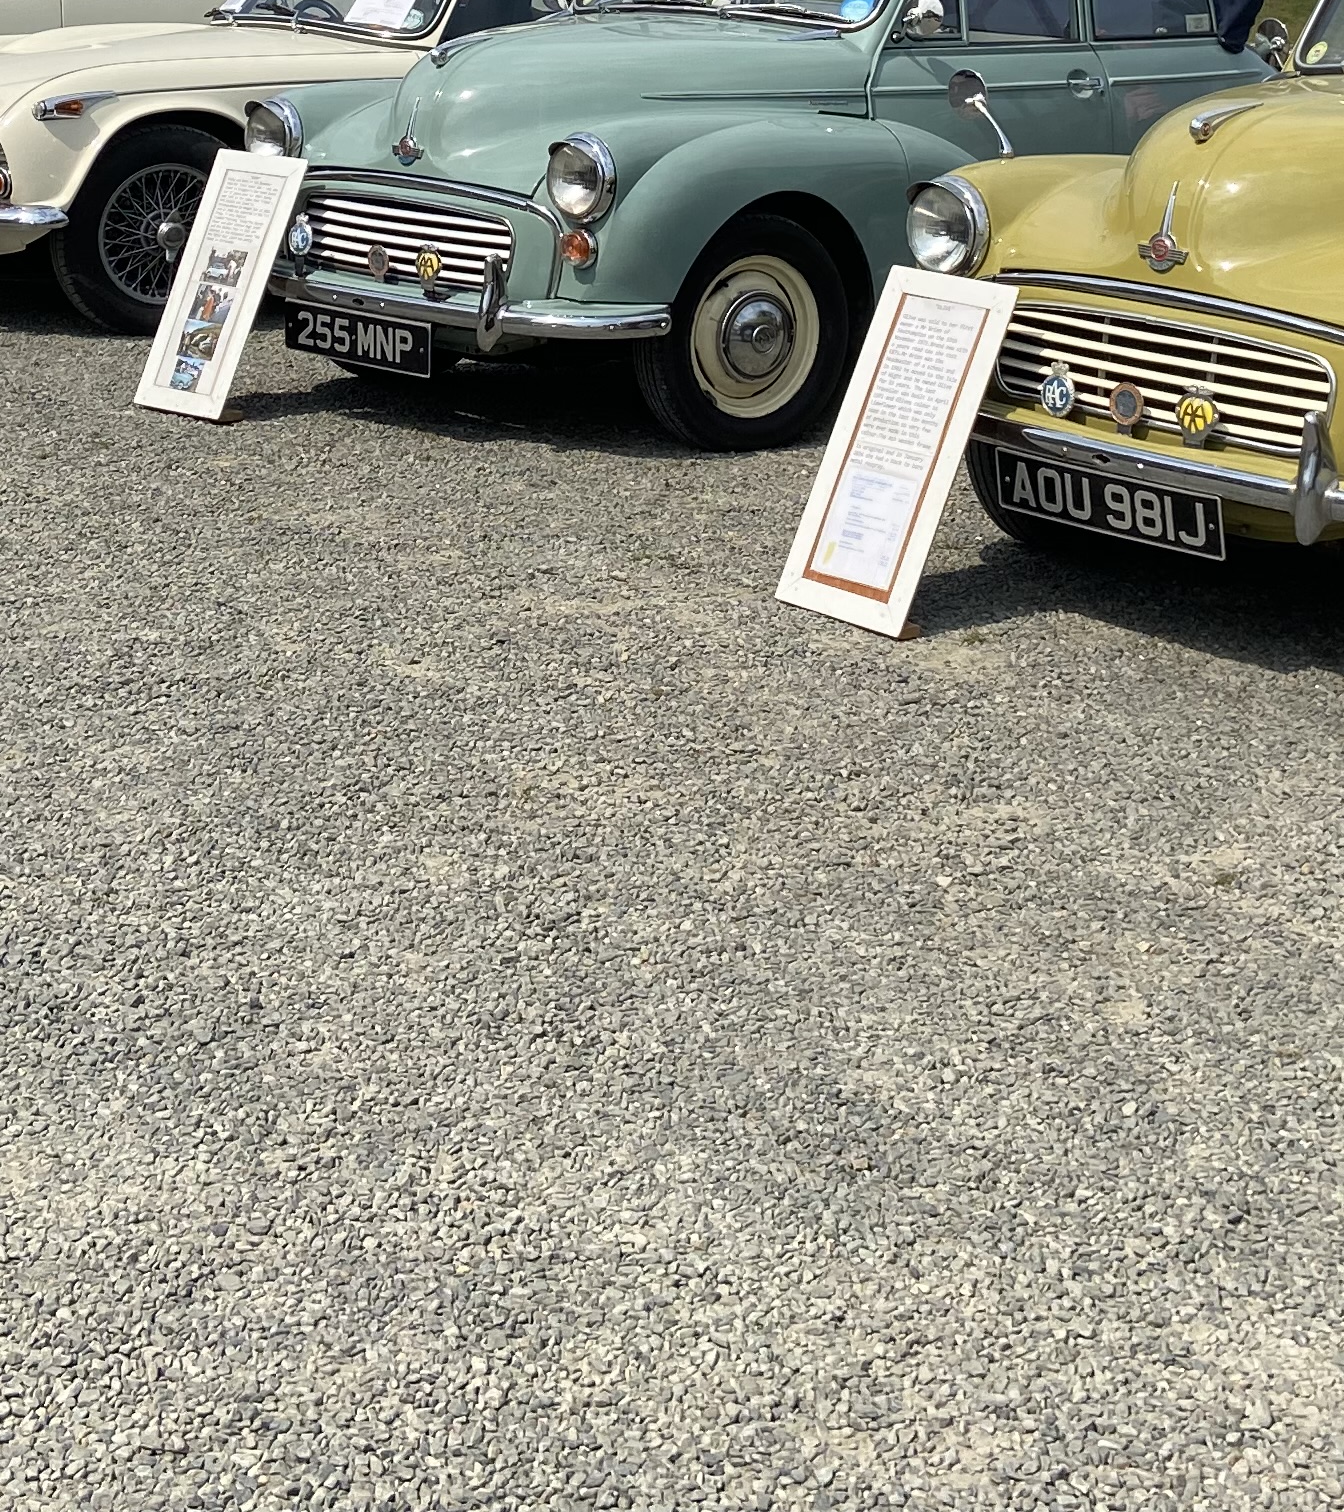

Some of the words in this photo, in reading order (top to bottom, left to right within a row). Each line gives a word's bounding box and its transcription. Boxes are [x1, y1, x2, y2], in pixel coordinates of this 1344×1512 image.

[297, 311, 350, 353] 255
[357, 321, 413, 364] MNP
[1045, 379, 1067, 409] RAC
[1012, 461, 1092, 520] AOU
[1104, 483, 1206, 547] 981J
